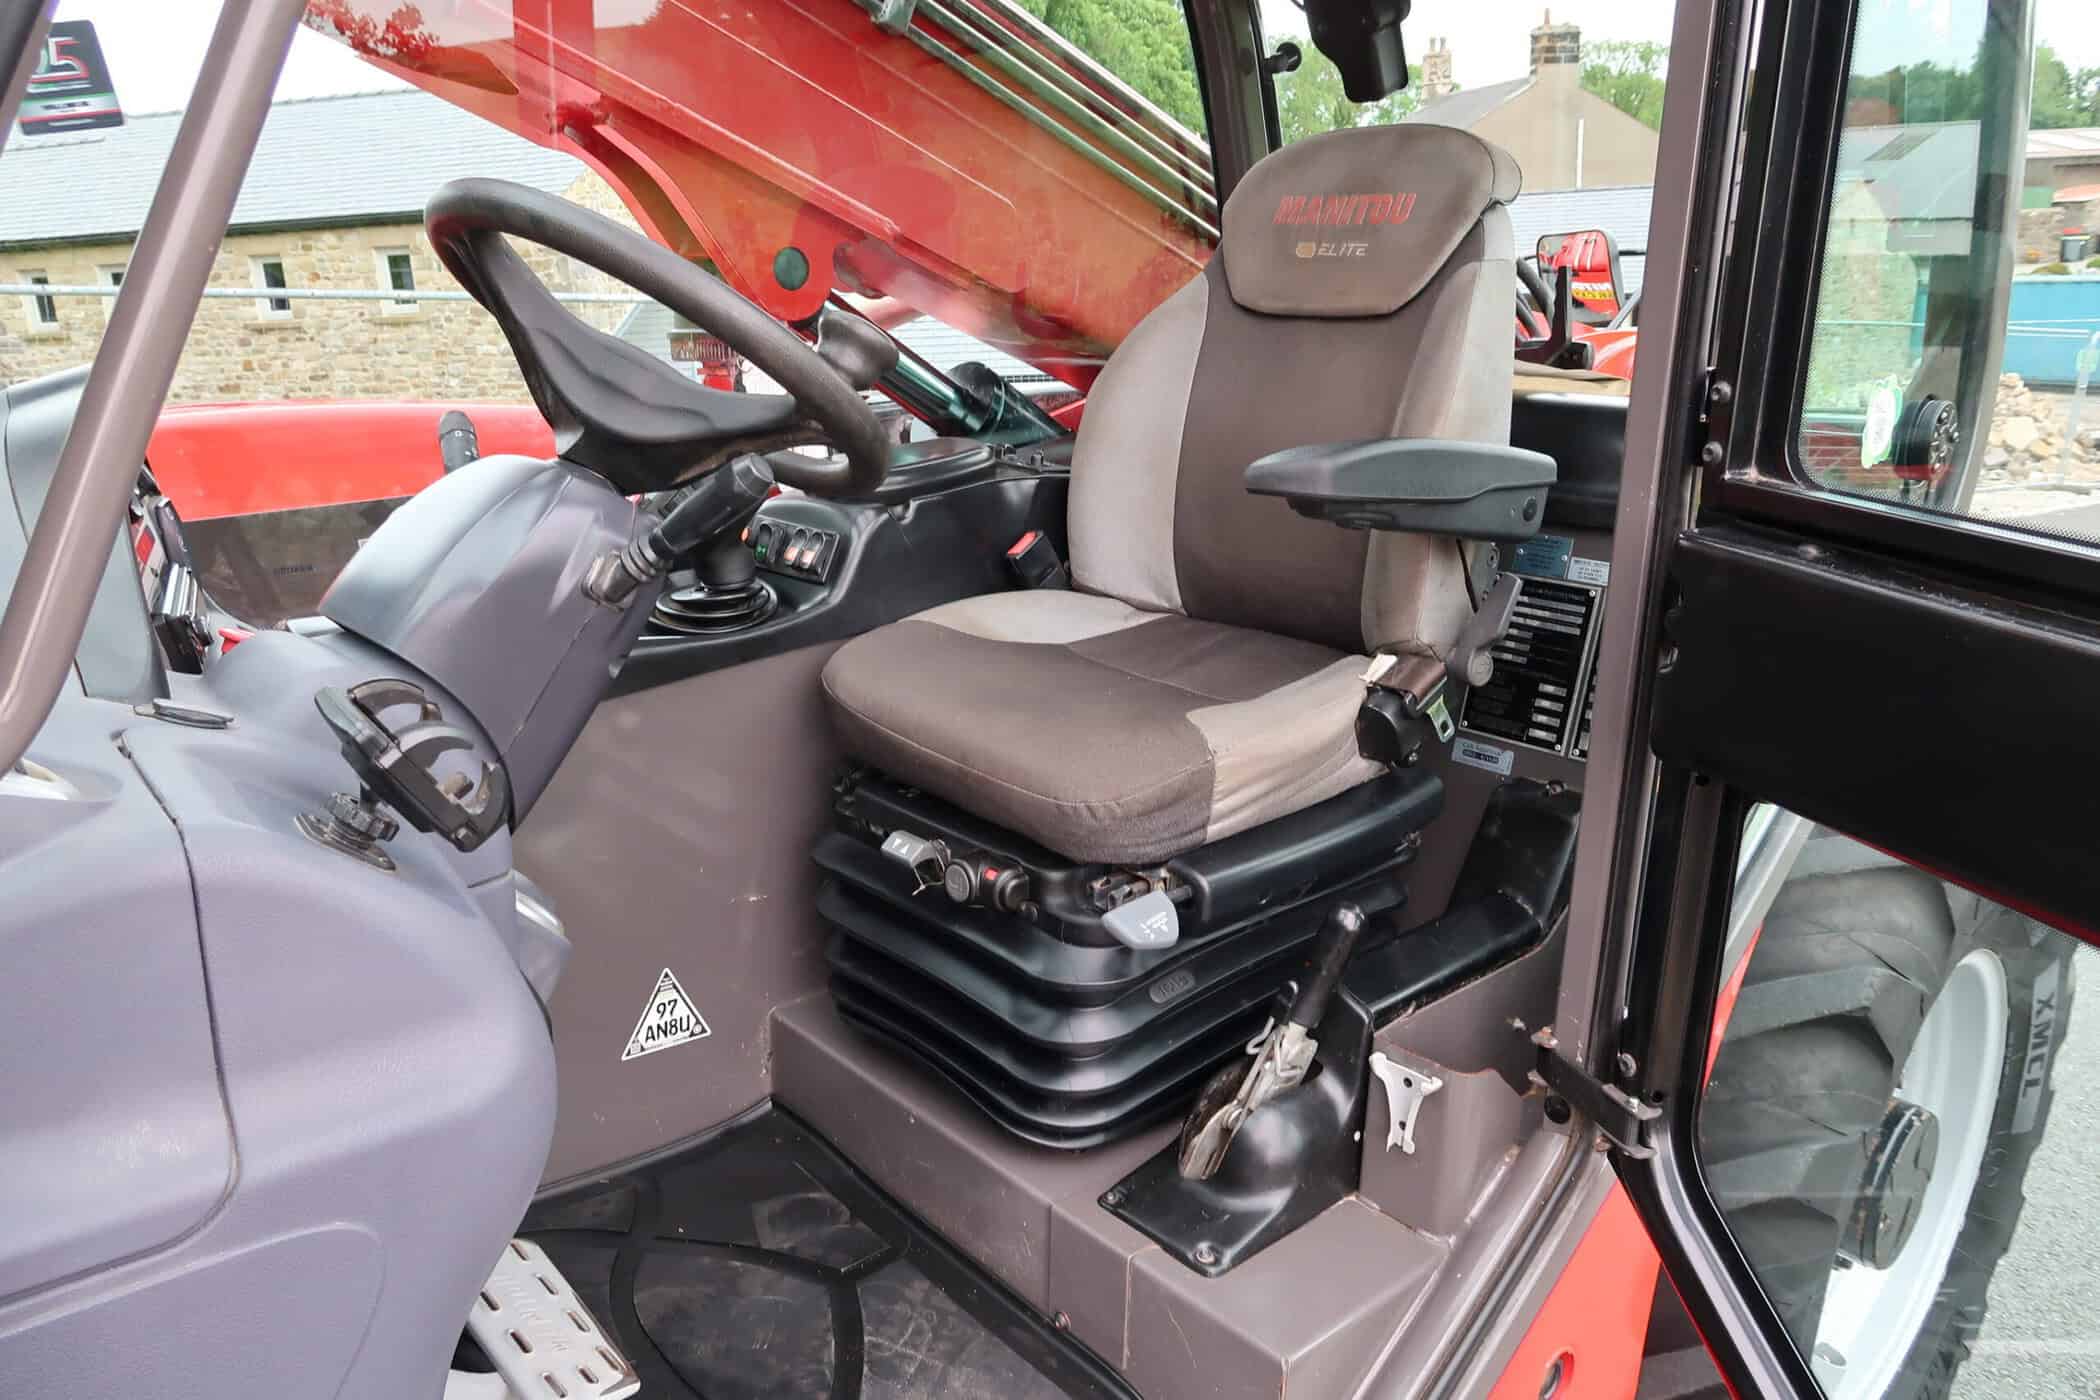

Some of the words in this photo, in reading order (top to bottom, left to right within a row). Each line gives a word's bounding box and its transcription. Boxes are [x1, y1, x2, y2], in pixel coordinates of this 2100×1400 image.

[1272, 192, 1417, 225] MANITOU
[1317, 242, 1369, 257] ELITE
[655, 998, 678, 1019] 97
[2022, 995, 2054, 1099] XMCL
